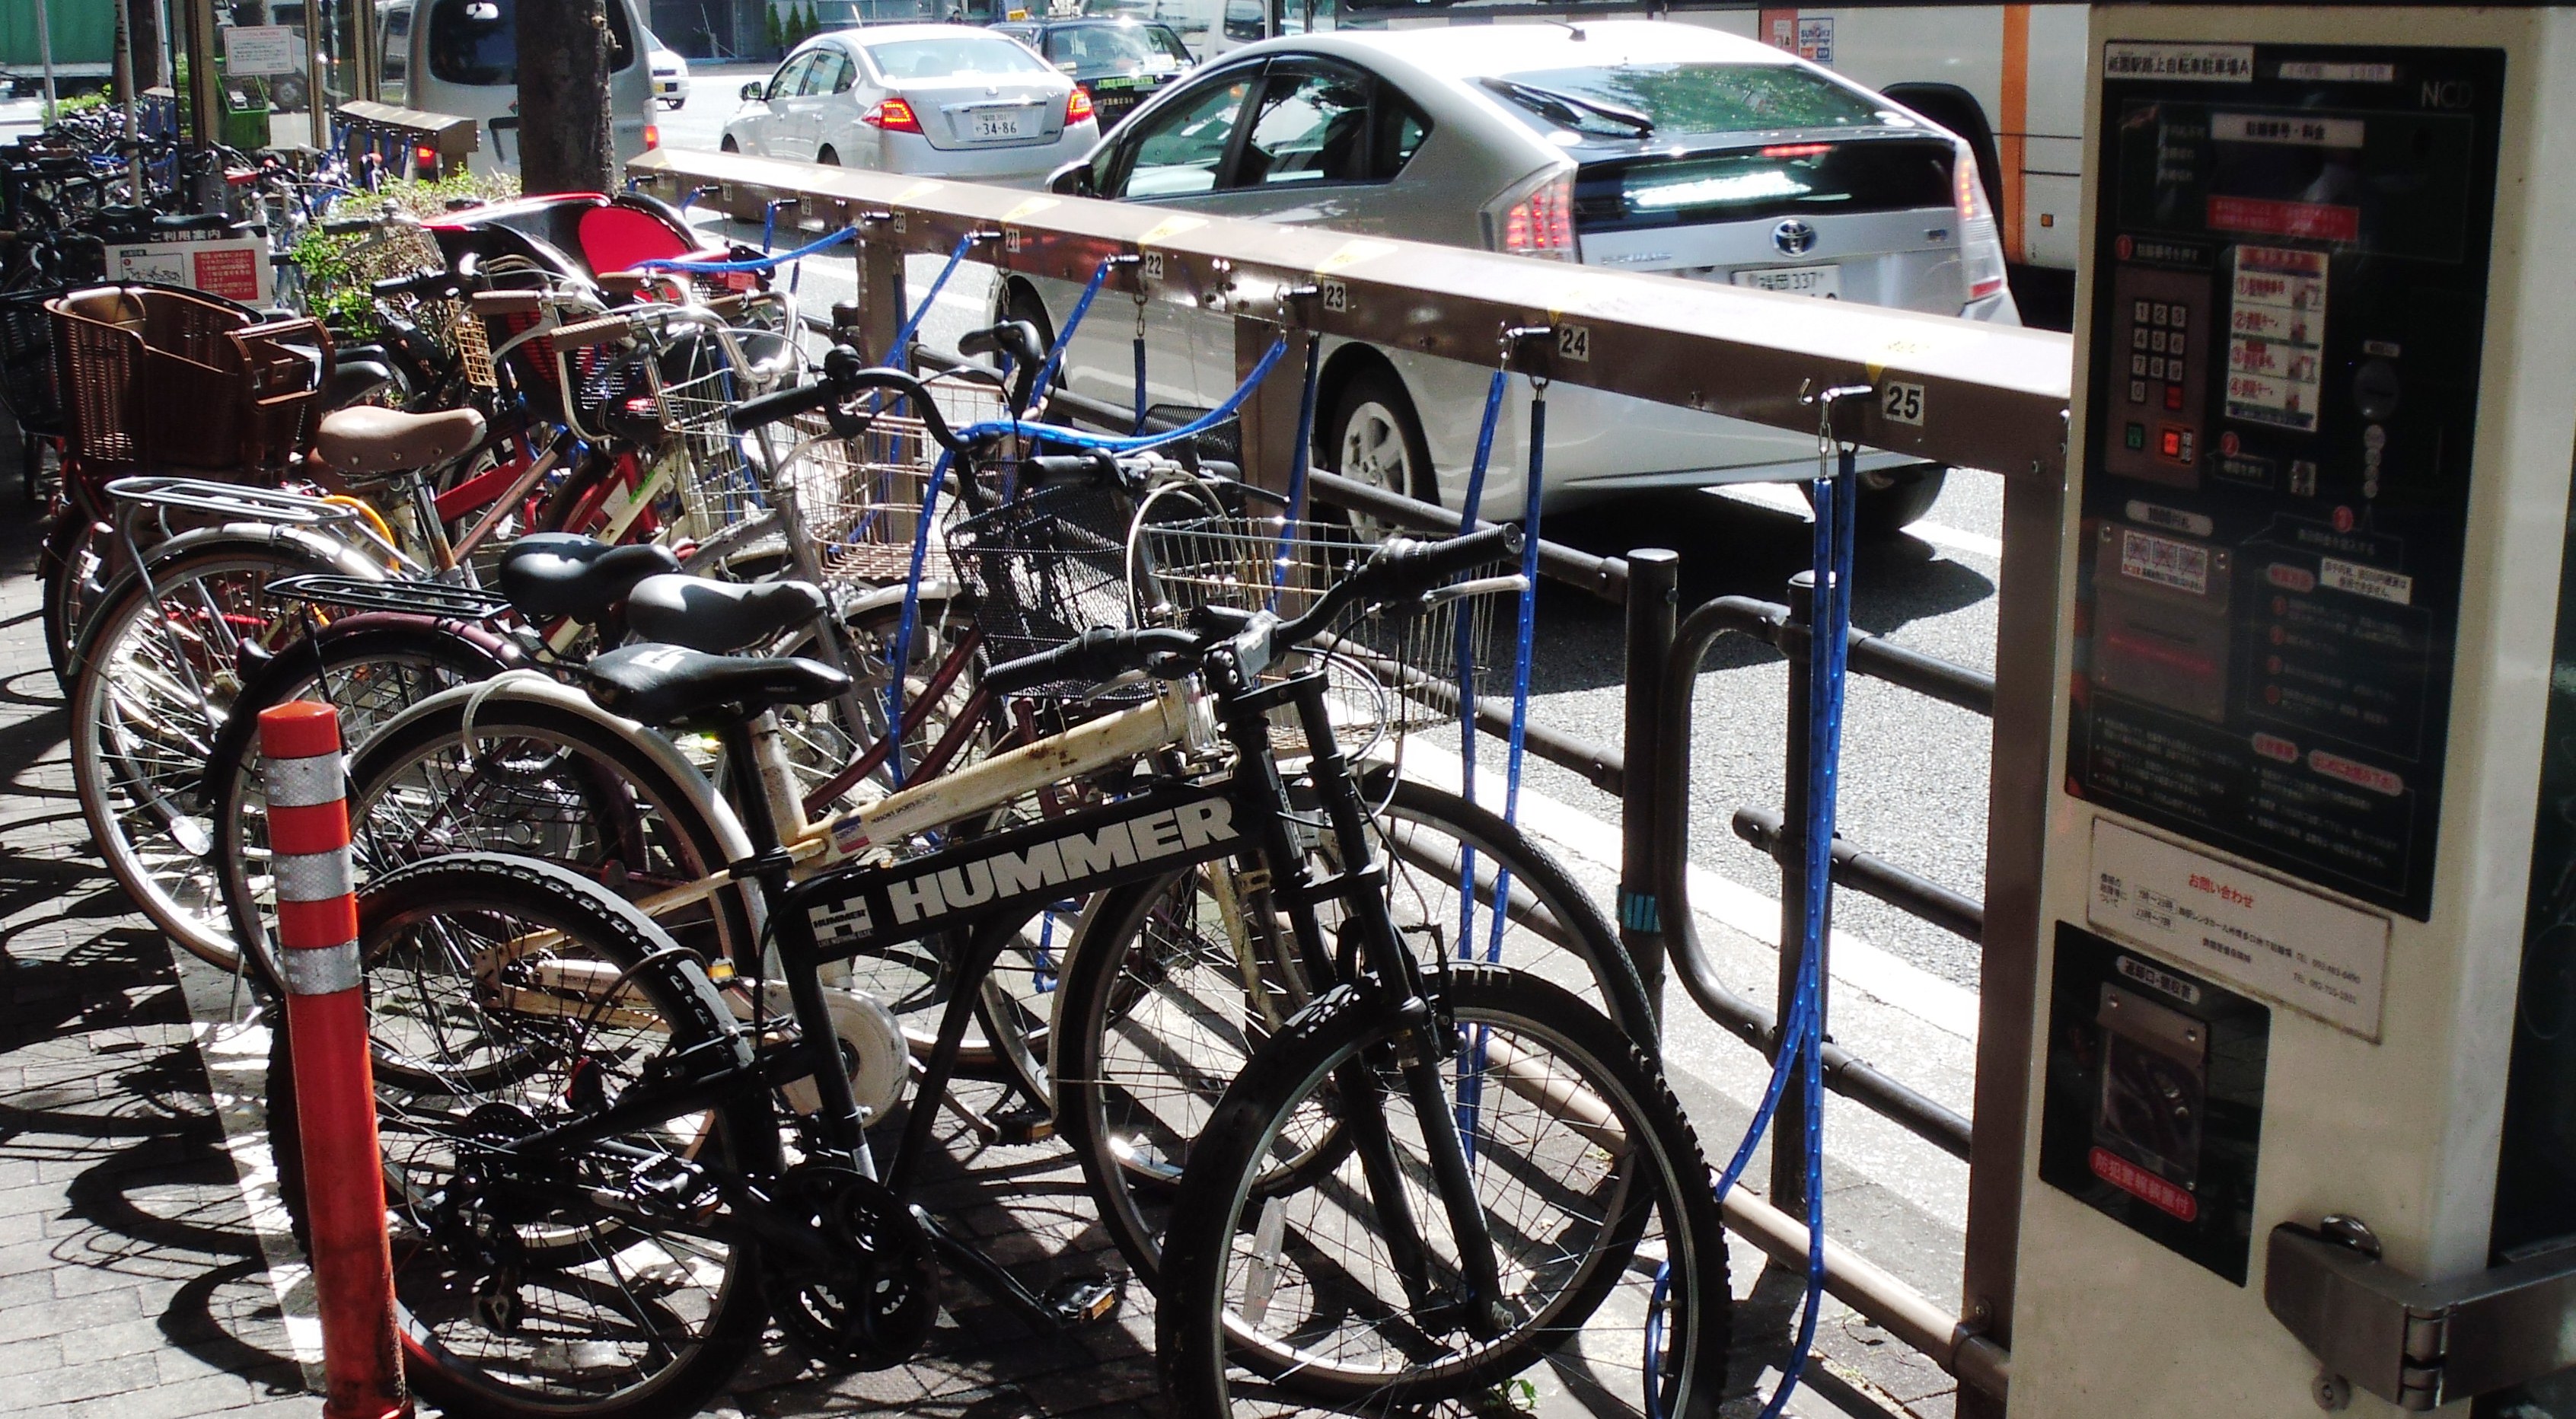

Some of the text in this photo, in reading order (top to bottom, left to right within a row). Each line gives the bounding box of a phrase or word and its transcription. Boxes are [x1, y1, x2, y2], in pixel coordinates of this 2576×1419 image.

[2421, 81, 2473, 109] NCD
[983, 122, 1016, 135] 34-86
[896, 214, 904, 229] 20
[145, 228, 211, 241] ご利用案内
[1008, 232, 1017, 248] 21
[1147, 255, 1162, 275] 22
[1326, 285, 1344, 308] 23
[1561, 329, 1586, 356] 24
[1886, 385, 1921, 419] 25
[887, 796, 1239, 924] HUMMER
[2189, 873, 2255, 908] お問い合わせ
[813, 909, 866, 928] HUMMER
